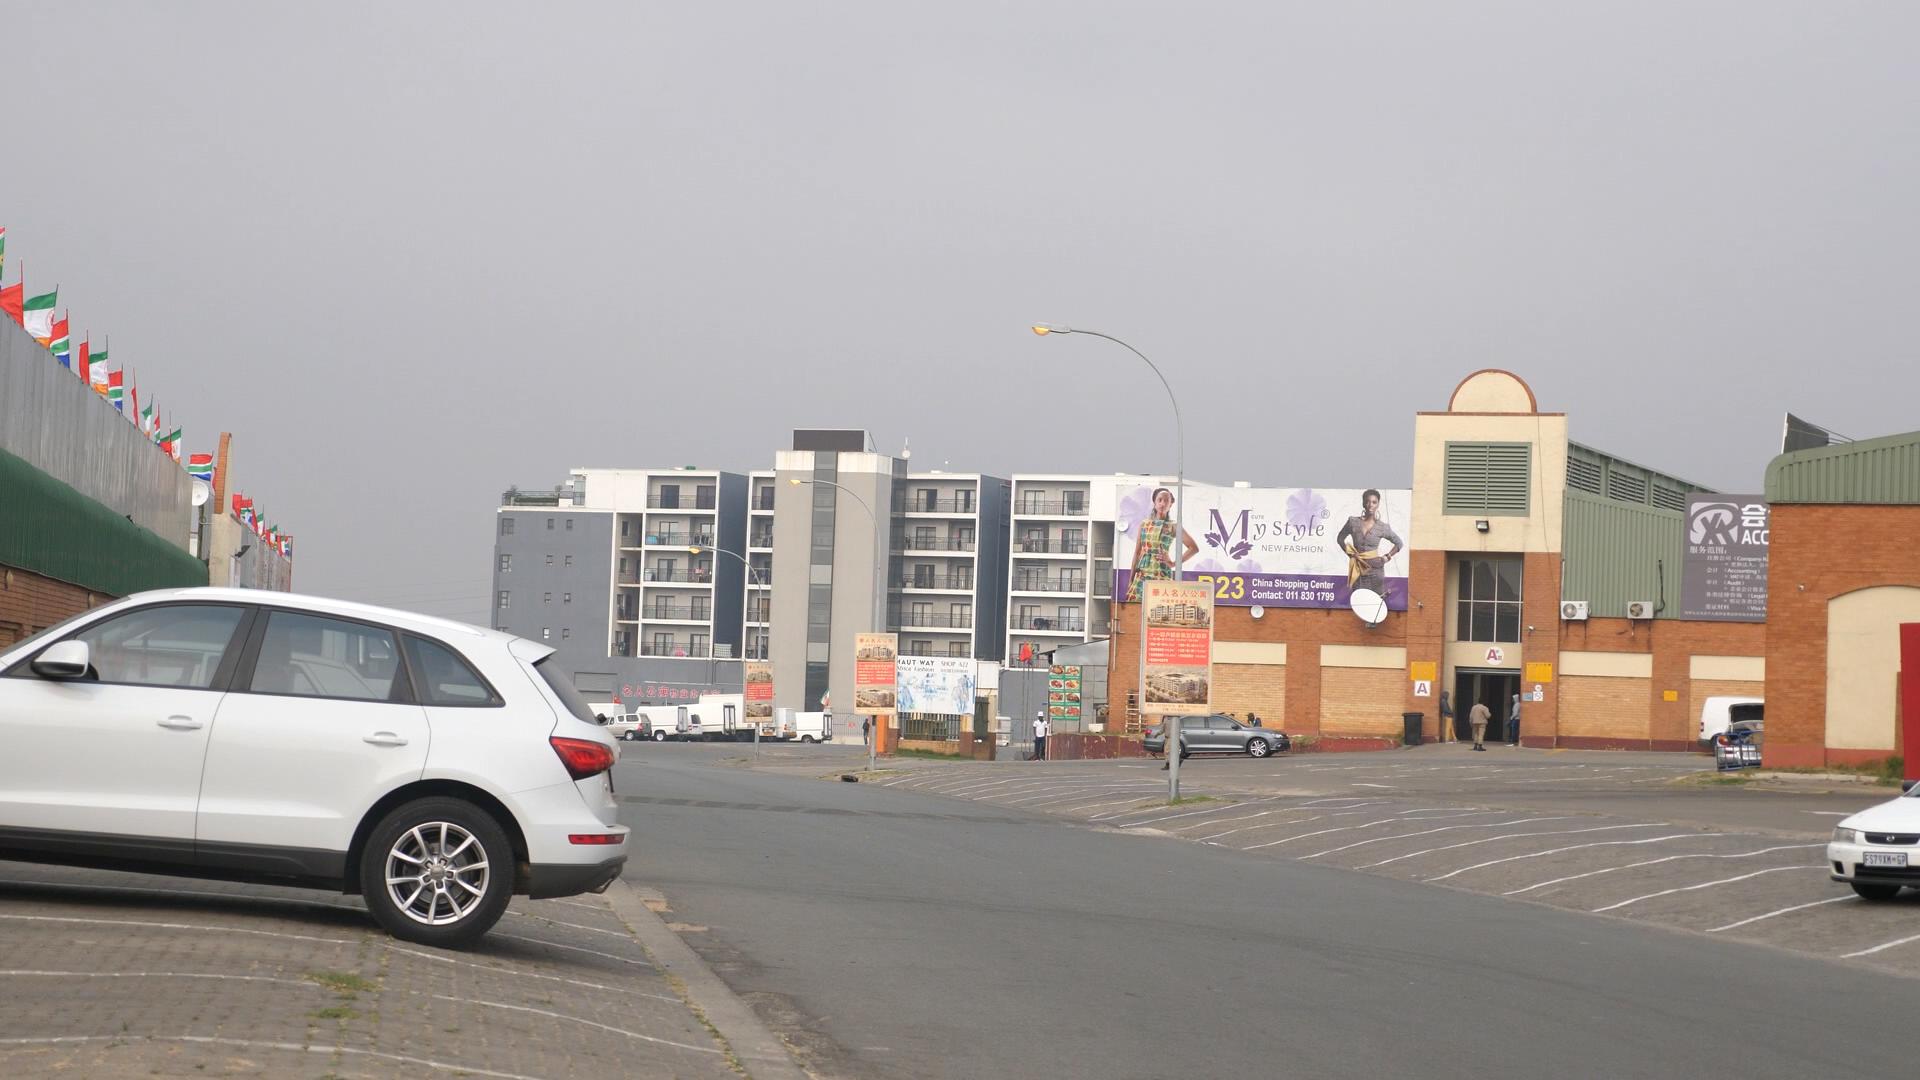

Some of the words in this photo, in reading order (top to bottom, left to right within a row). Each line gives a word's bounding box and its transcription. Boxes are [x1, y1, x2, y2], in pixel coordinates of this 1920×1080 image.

[1741, 504, 1770, 527] 会
[1273, 515, 1325, 541] Style
[1741, 530, 1770, 545] ACC
[1261, 544, 1283, 553] NEW
[1284, 545, 1323, 553] FASHION
[1252, 578, 1273, 587] China
[1274, 579, 1309, 591] Shopping
[1310, 580, 1335, 589] Center
[1252, 590, 1284, 600] Contact:
[1286, 591, 1298, 600] 011
[1301, 592, 1314, 600] 830
[1317, 592, 1335, 601] 1799
[1417, 683, 1428, 694] A
